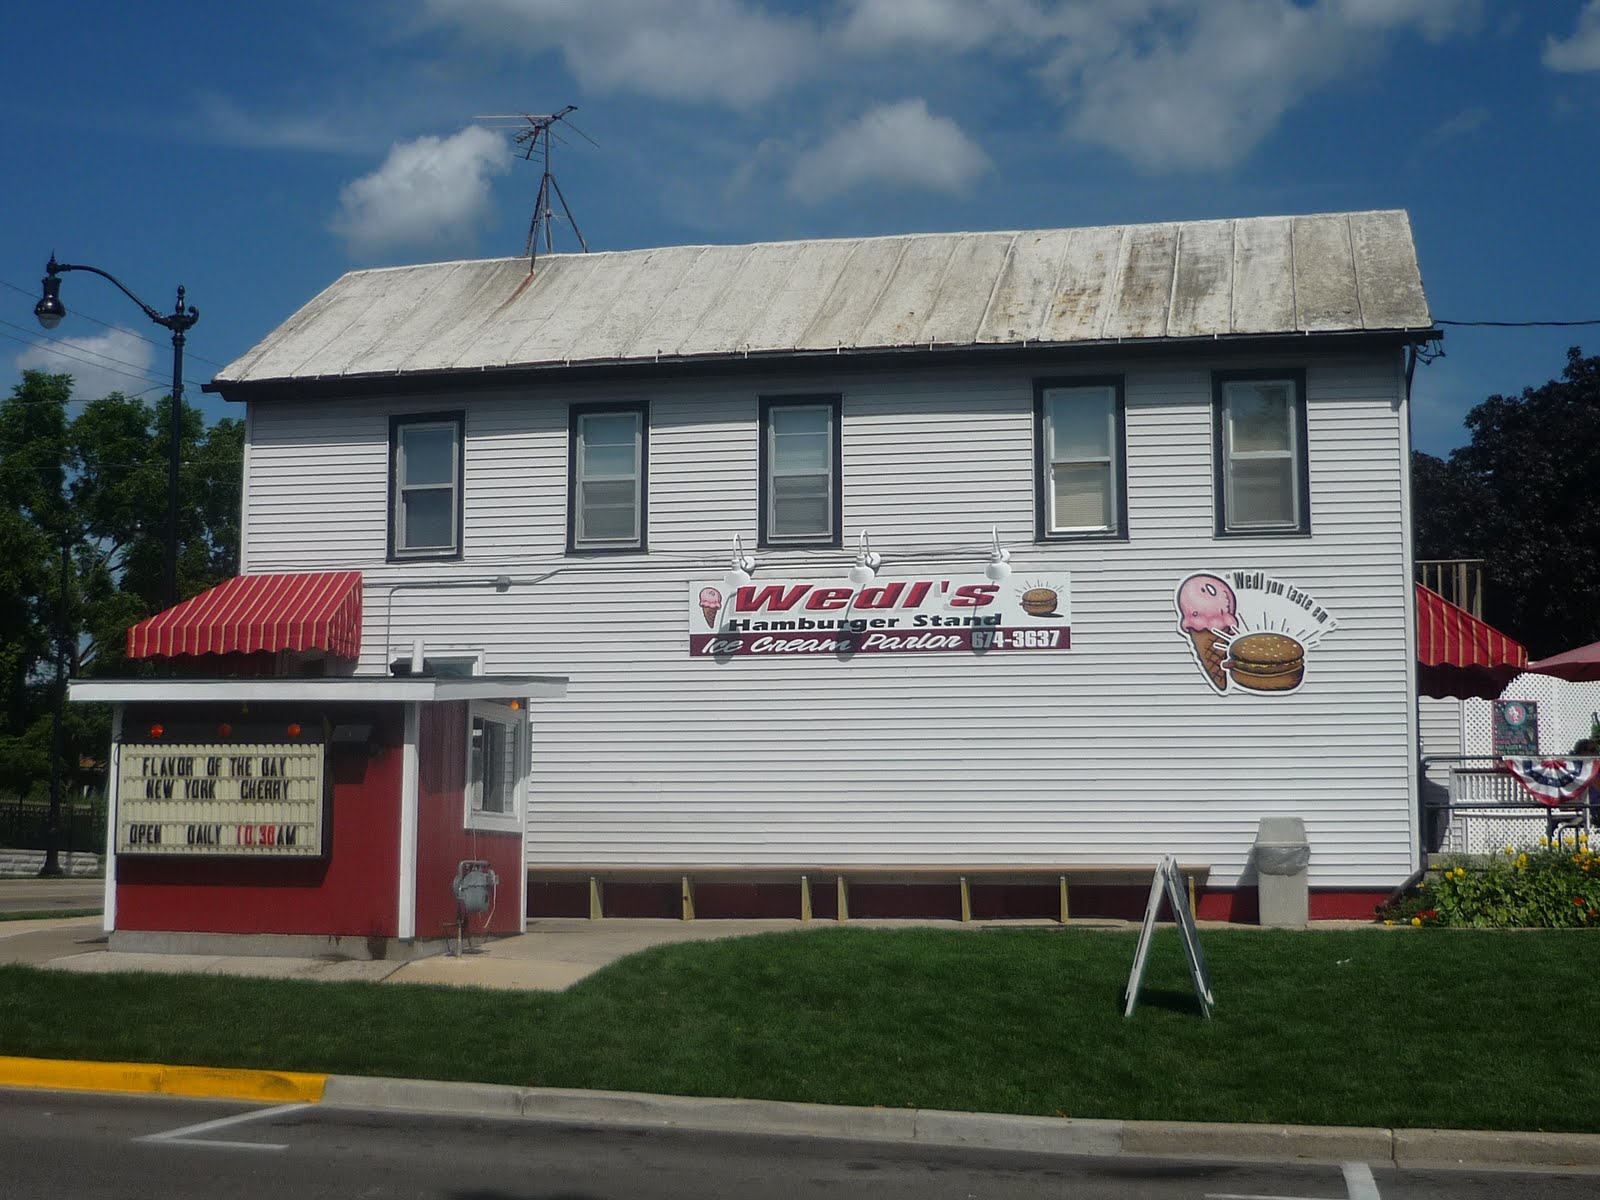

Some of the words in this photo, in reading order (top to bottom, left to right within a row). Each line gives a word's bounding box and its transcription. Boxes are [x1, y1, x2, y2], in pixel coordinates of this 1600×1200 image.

[735, 581, 1000, 613] Wedl's
[1264, 579, 1285, 595] you
[1286, 585, 1313, 611] taste
[729, 615, 900, 632] Hamburger
[912, 613, 1002, 627] Stand
[702, 637, 742, 653] Ice
[750, 636, 852, 653] Cream
[862, 632, 963, 650] Parlor
[971, 630, 1060, 649] 674-3637
[142, 757, 194, 777] FLAVOR
[207, 757, 222, 776] OF
[229, 757, 251, 776] THE
[262, 757, 287, 776] DAY
[146, 779, 174, 799] NEW
[184, 779, 216, 799] YORK
[241, 779, 289, 799] CHERRY
[130, 824, 162, 844] OPEN
[187, 824, 222, 845] DAILY
